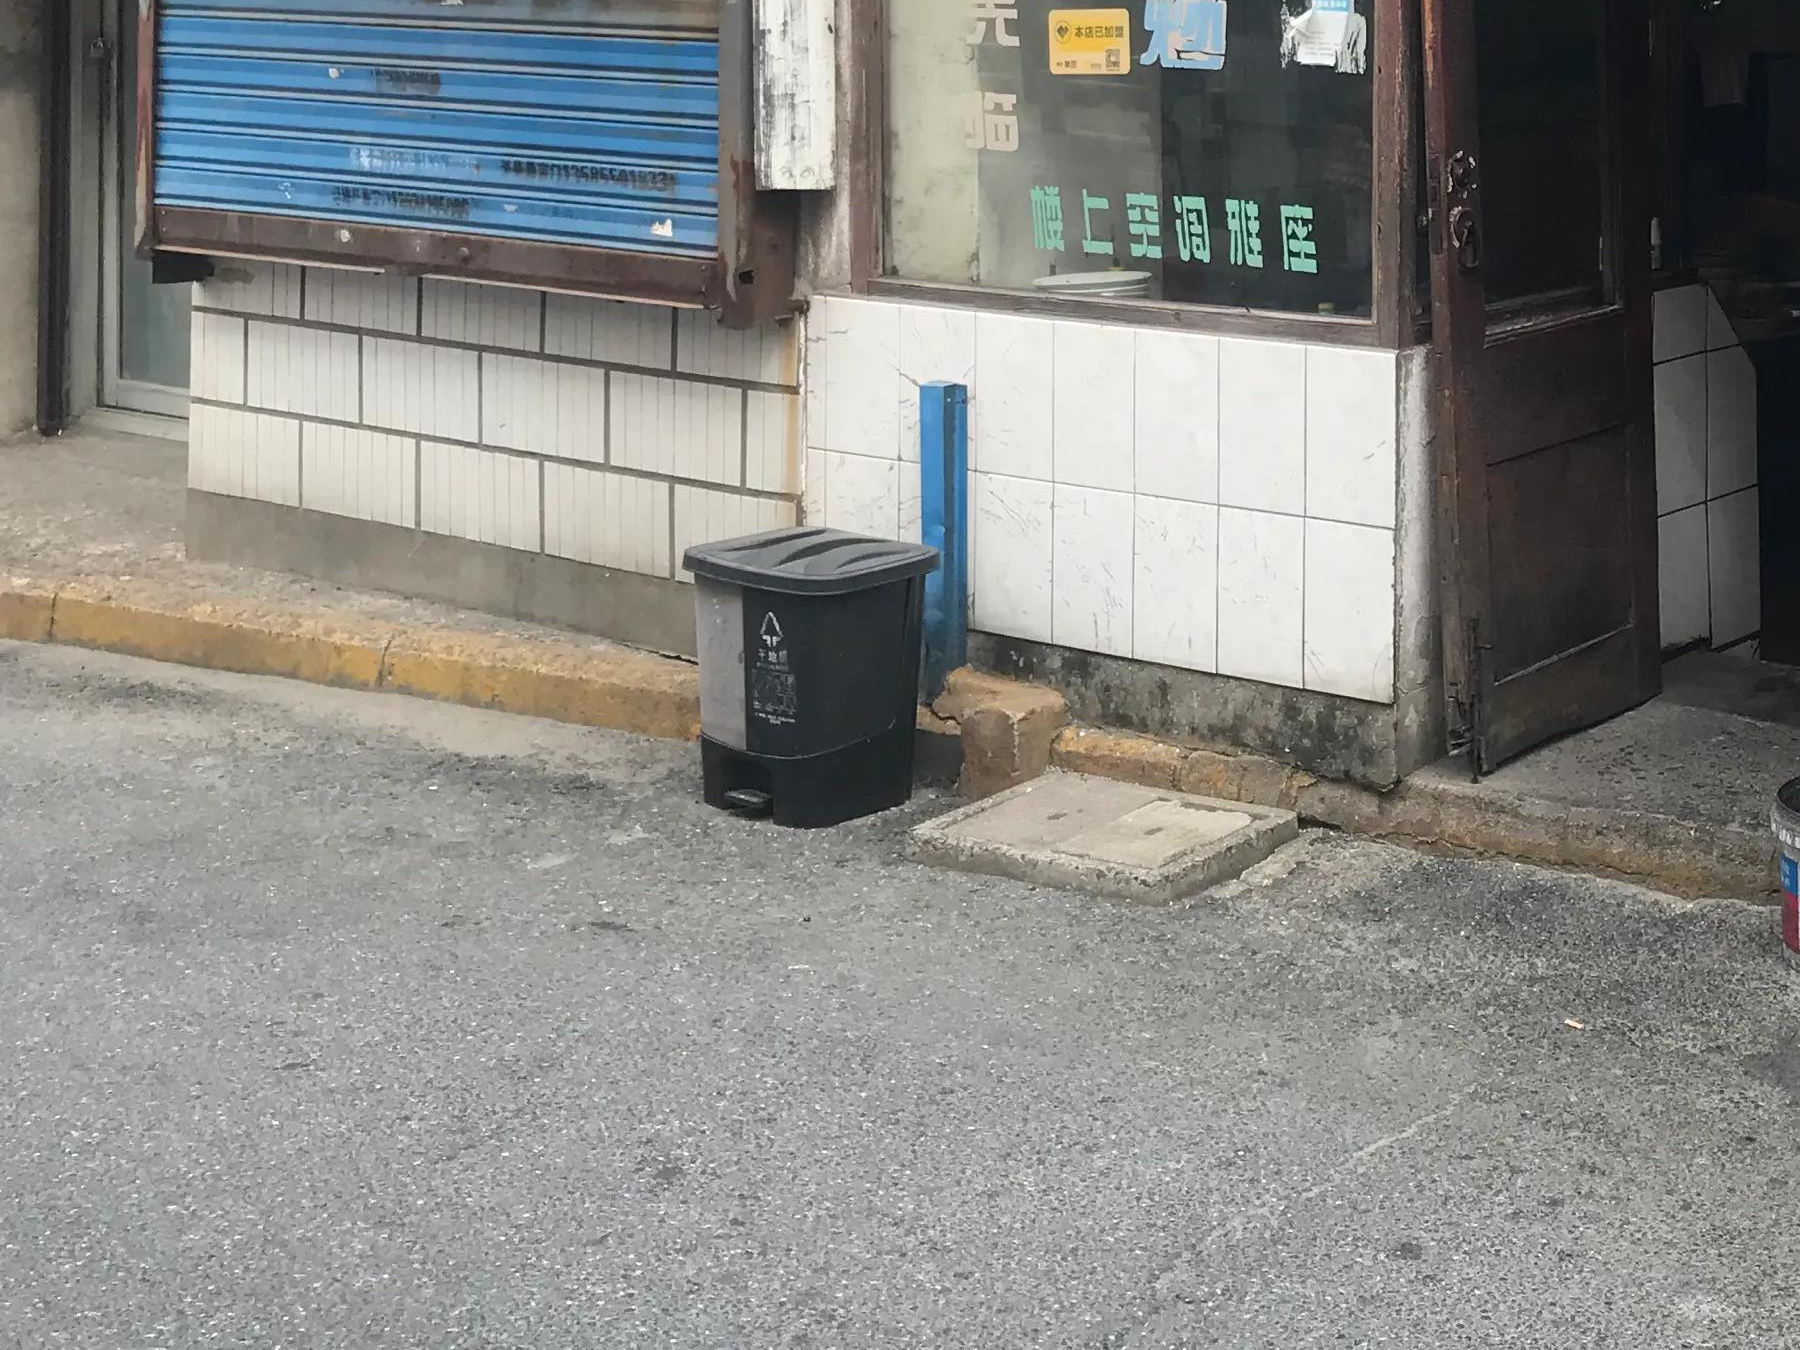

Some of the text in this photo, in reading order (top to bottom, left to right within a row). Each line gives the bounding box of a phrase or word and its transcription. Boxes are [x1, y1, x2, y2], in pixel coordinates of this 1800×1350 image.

[1030, 185, 1318, 274] 楼上空调雅座
